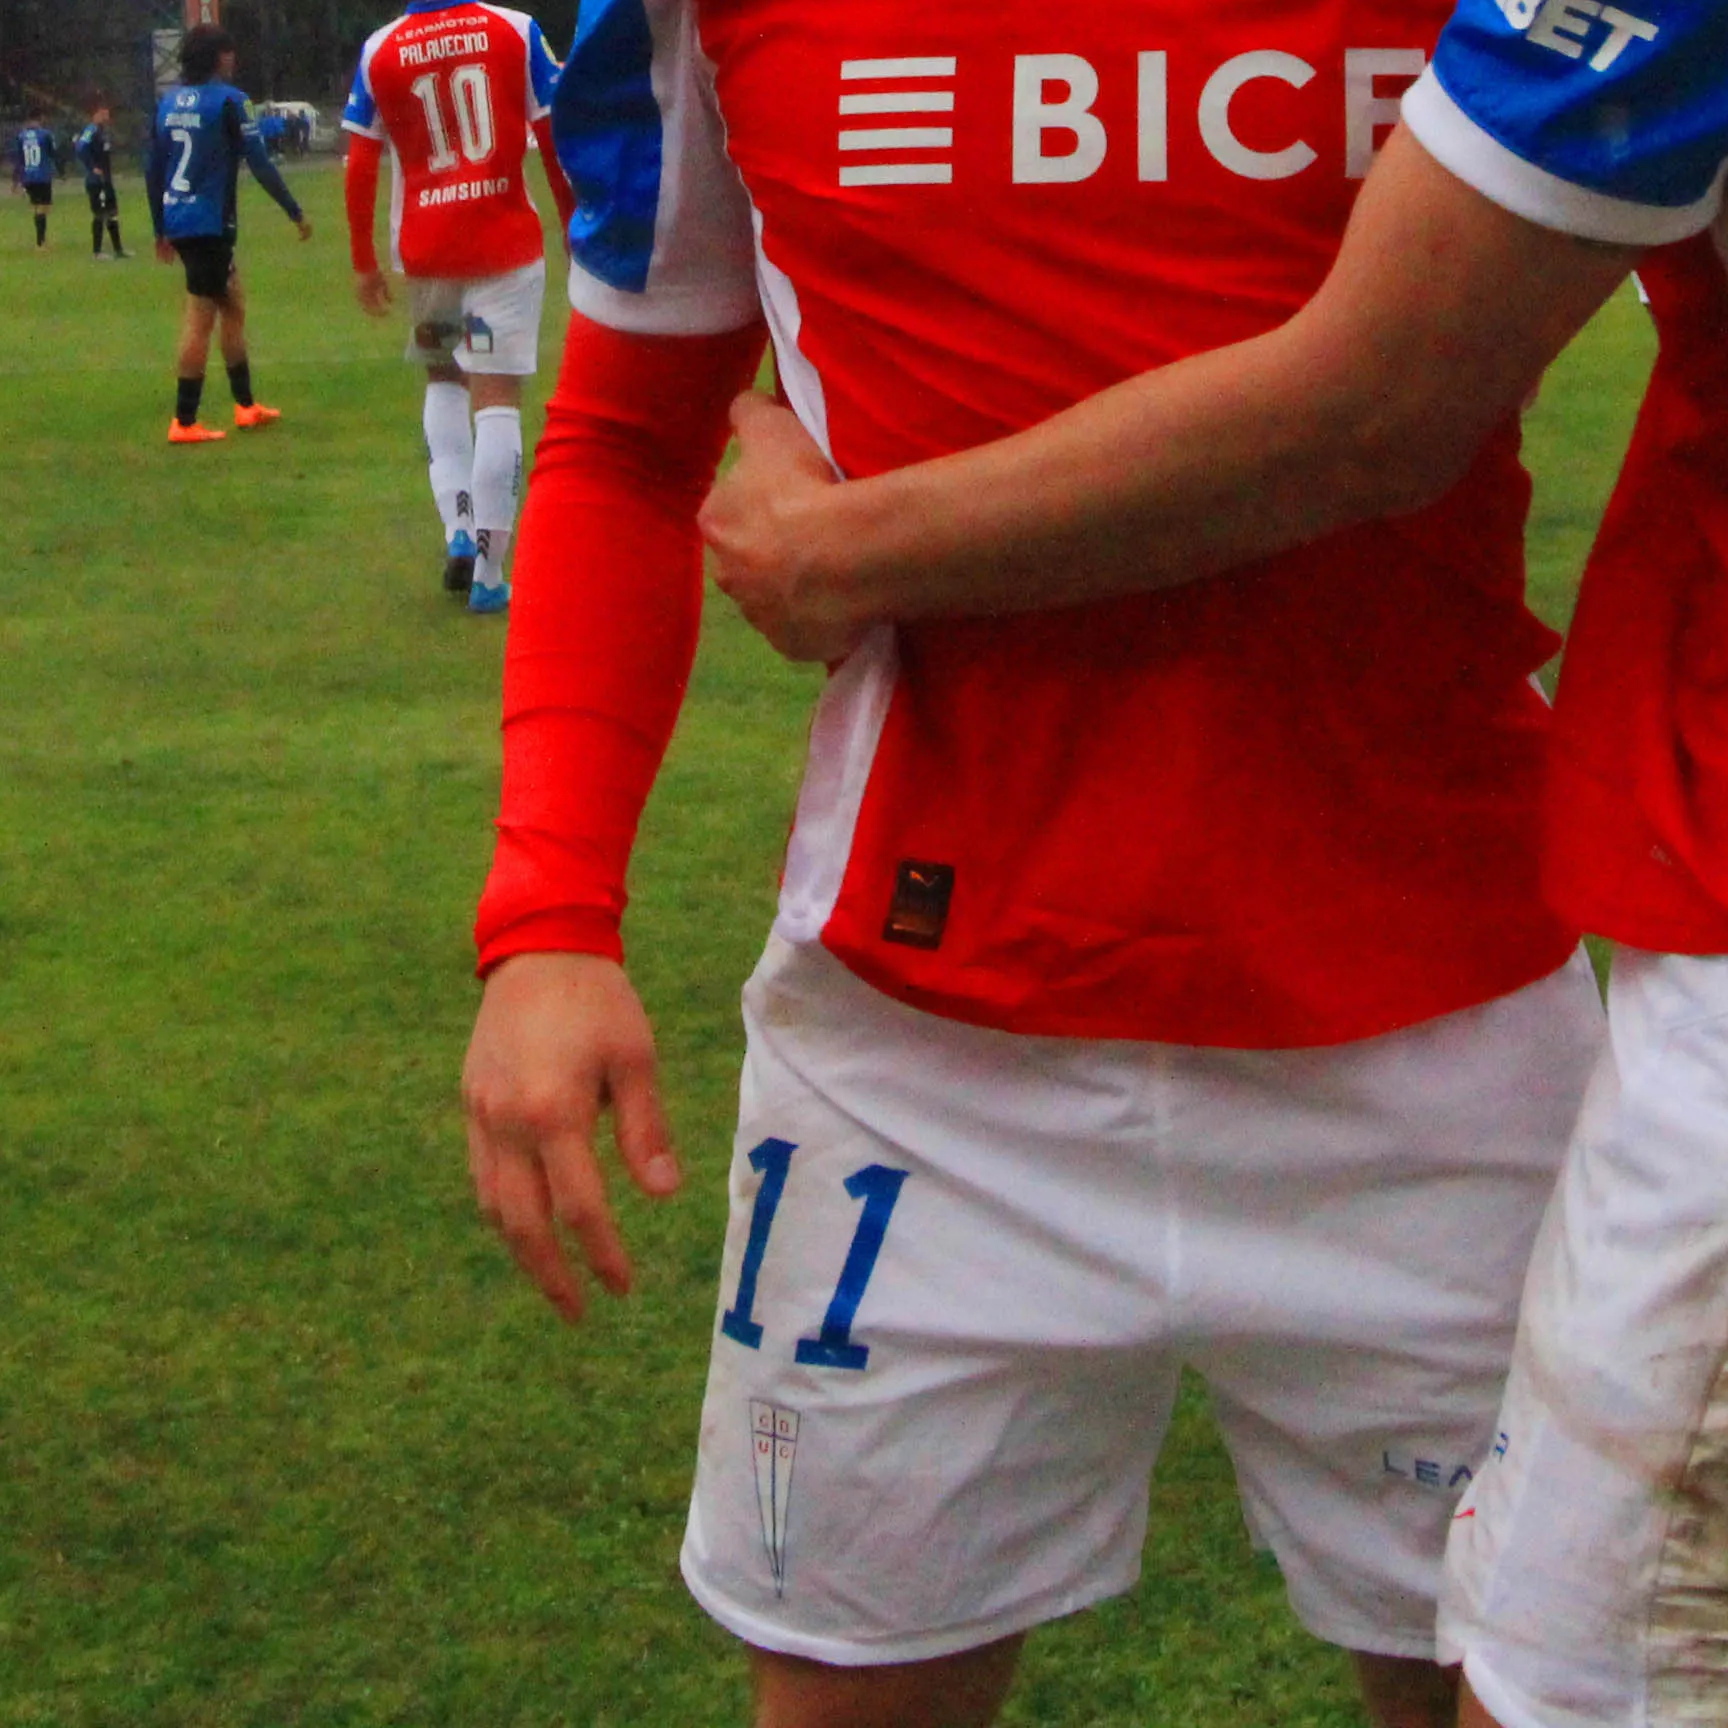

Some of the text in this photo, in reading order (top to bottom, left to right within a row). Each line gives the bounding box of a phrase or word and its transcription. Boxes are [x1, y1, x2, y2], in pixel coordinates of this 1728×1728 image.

[398, 30, 489, 68] PALAVECINO
[410, 63, 496, 174] 10
[170, 128, 193, 192] 2
[418, 176, 510, 207] SAMSUNG
[721, 1136, 911, 1371] 11
